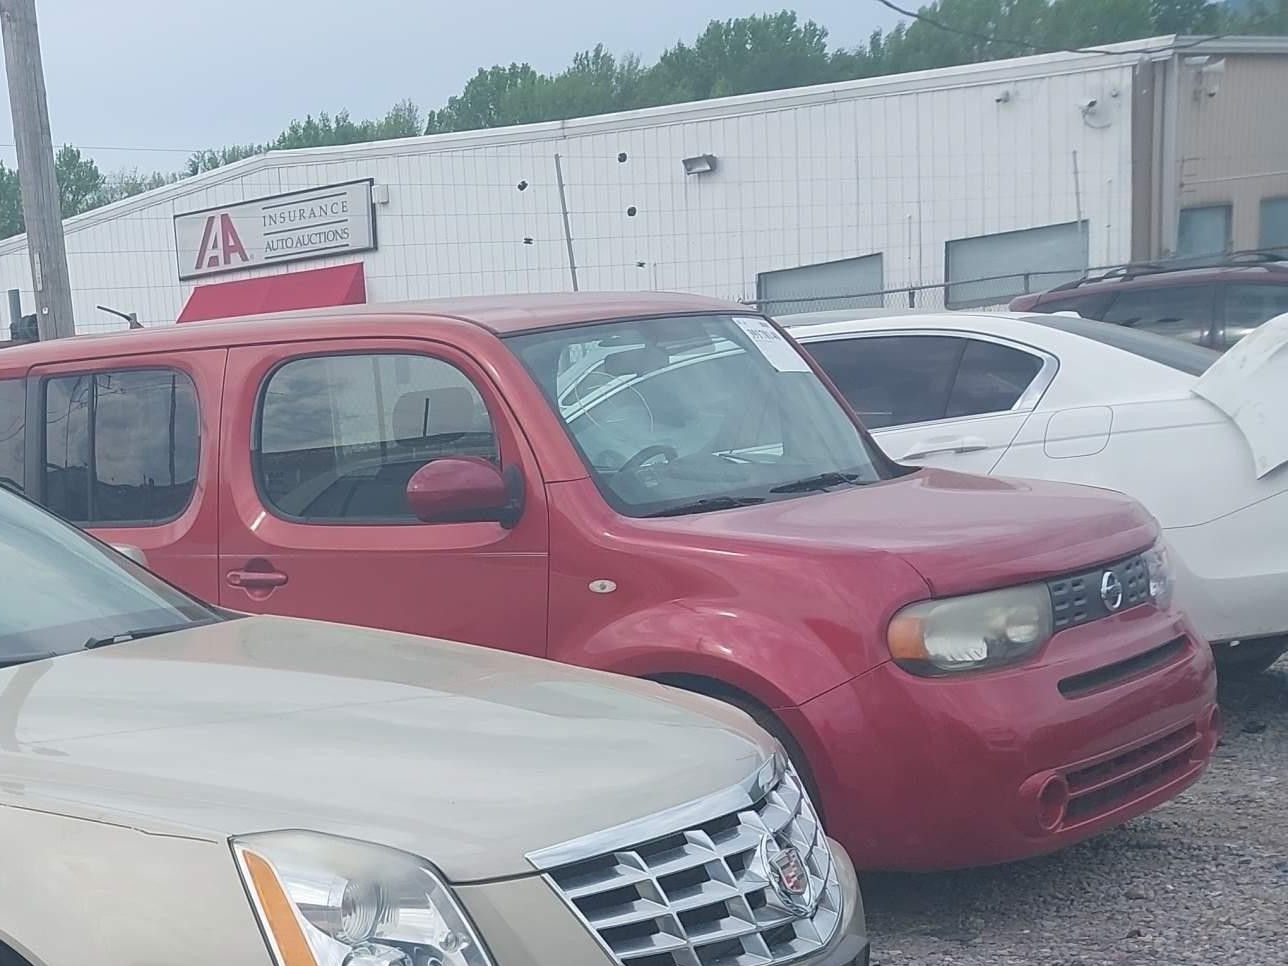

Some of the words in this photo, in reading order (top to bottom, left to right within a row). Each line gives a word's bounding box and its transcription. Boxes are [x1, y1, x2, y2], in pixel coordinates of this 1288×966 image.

[262, 200, 349, 227] INSURANCE
[264, 237, 294, 253] AUTO
[295, 227, 350, 249] AUCTIONS
